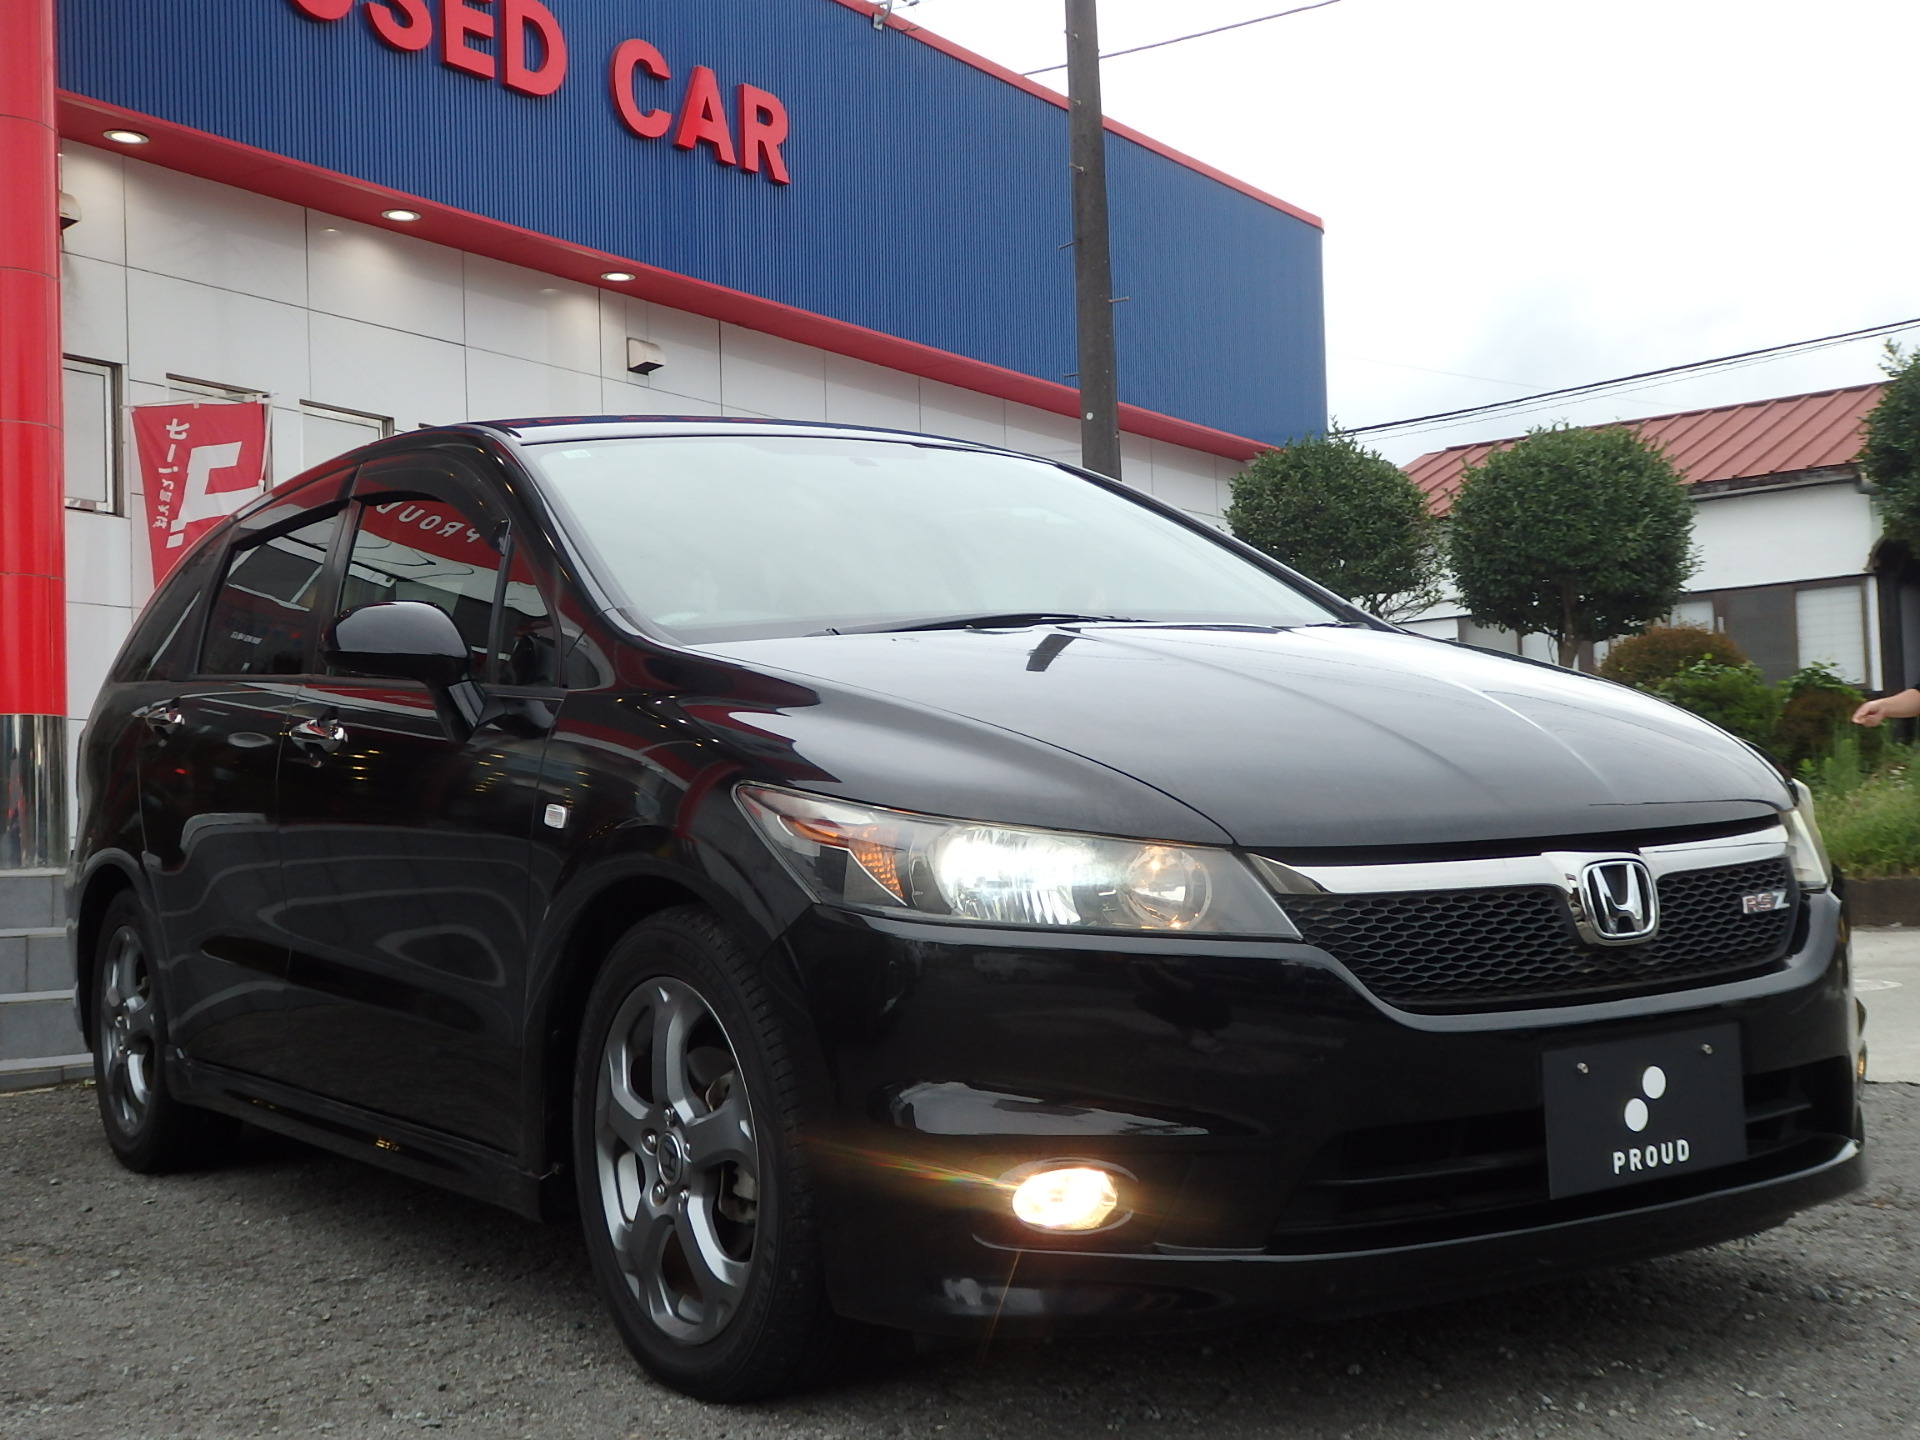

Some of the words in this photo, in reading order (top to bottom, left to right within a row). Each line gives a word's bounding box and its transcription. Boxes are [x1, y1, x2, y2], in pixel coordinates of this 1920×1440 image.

[290, 0, 569, 97] SED
[611, 38, 790, 185] CAR
[1742, 889, 1791, 914] RSZ
[1612, 1138, 1690, 1175] PROUD
